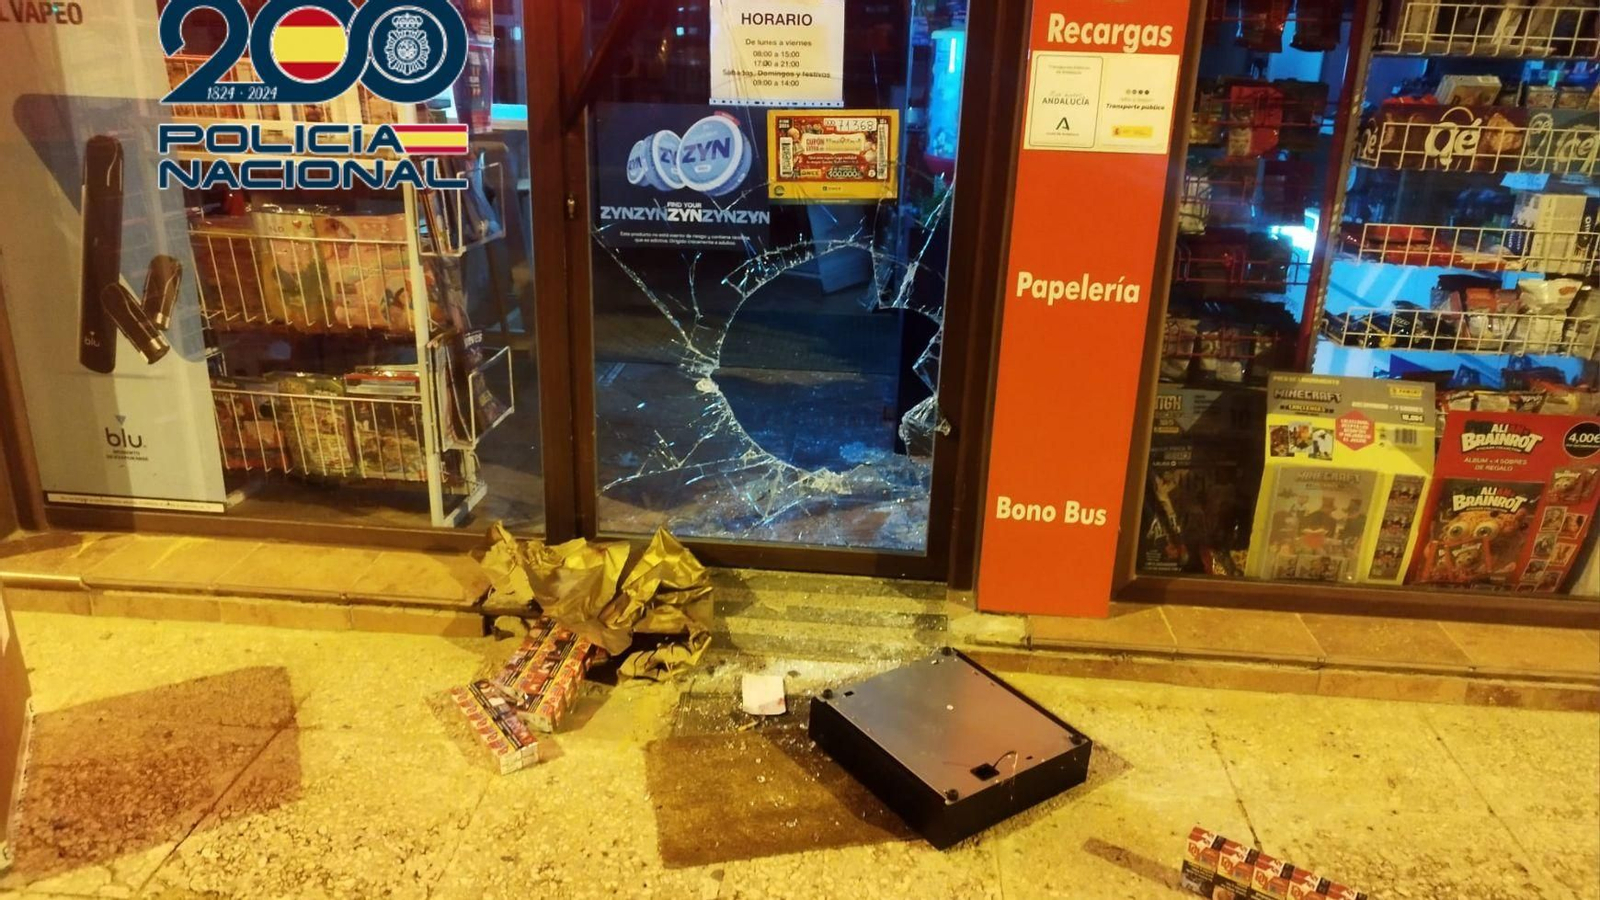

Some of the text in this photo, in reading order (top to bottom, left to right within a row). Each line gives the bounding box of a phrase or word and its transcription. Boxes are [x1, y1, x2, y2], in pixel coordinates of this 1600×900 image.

[9, 0, 84, 25] VAPEO
[741, 12, 813, 27] HORARIO
[745, 38, 756, 46] De
[757, 38, 777, 46] lunes
[785, 39, 812, 47] viernes
[1047, 12, 1173, 54] Recargas
[757, 70, 795, 79] Domingos
[801, 71, 831, 79] festivos
[681, 137, 731, 164] ZYN
[1016, 271, 1140, 306] Papelería
[84, 336, 100, 347] blu
[1273, 389, 1342, 404] MINECRAFT
[105, 426, 142, 448] blu
[1461, 432, 1544, 453] BRAINROT
[1568, 433, 1600, 444] 4,00€
[995, 496, 1107, 527] Bono Bus
[1452, 494, 1528, 513] BRAINROT
